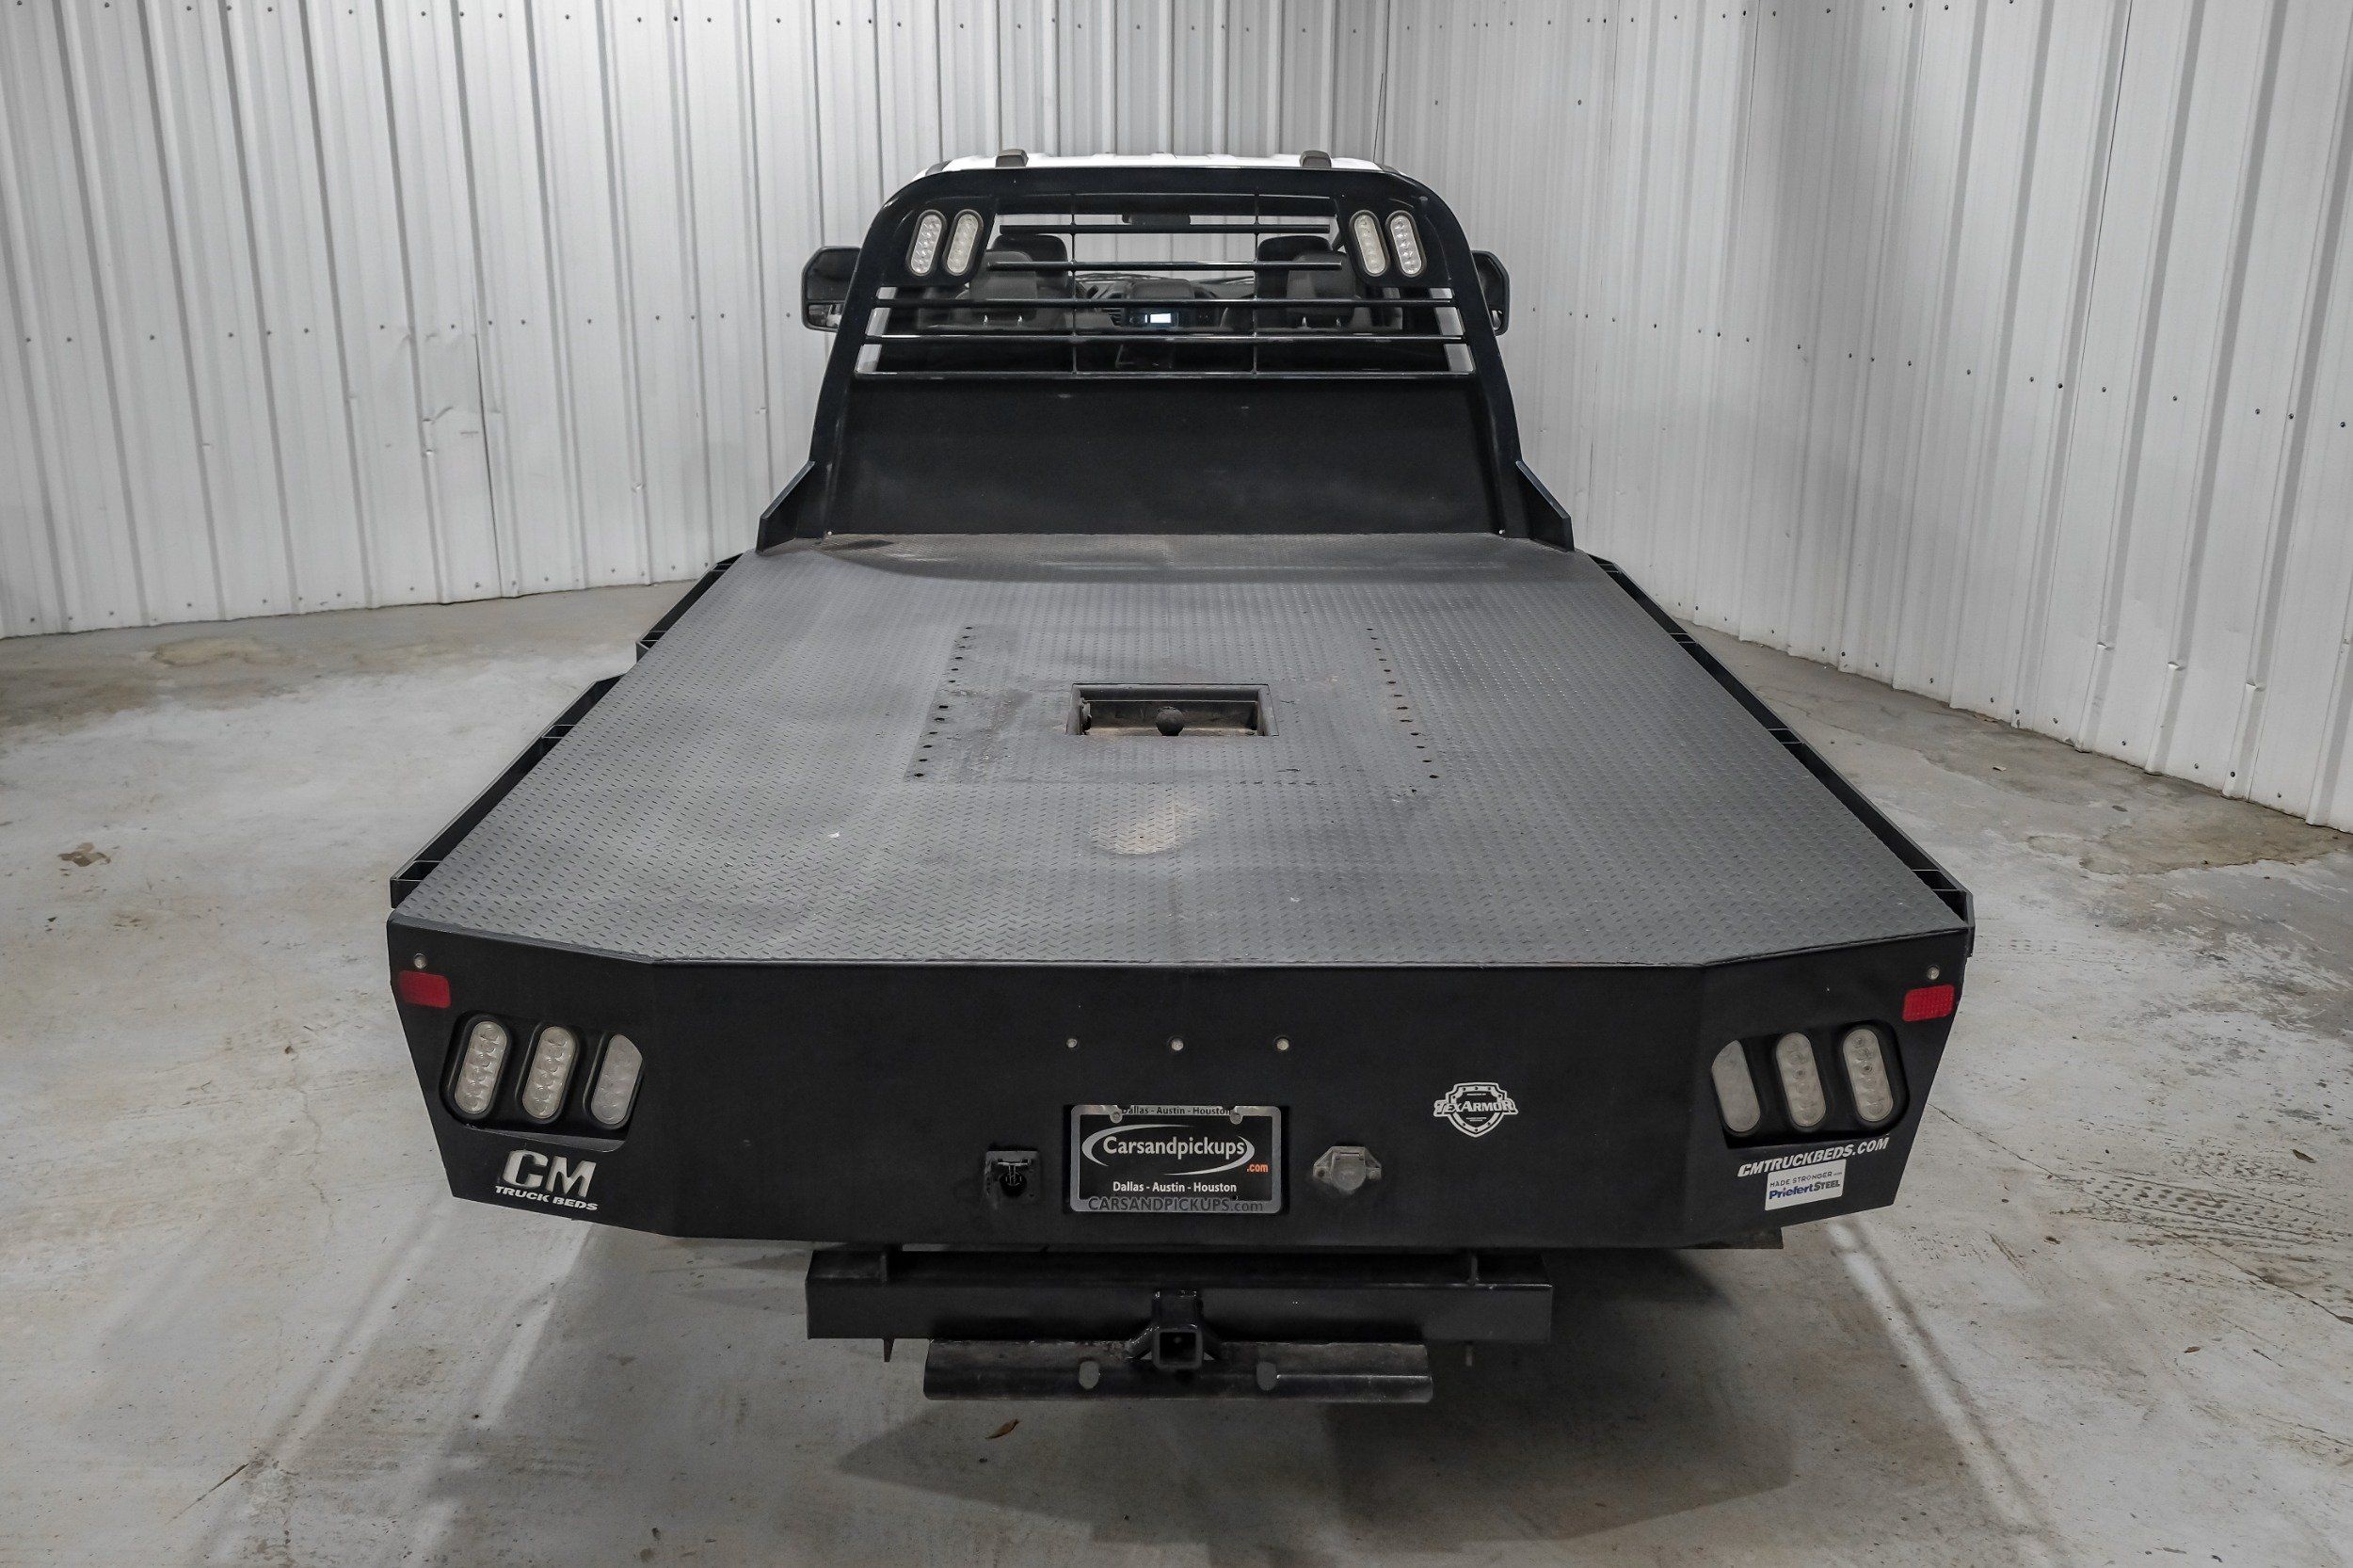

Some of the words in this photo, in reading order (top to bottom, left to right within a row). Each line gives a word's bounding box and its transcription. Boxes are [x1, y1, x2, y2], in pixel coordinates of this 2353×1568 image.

[1156, 1106, 1186, 1114] Austin
[1193, 1106, 1230, 1115] Houston
[1103, 1136, 1245, 1160] Carsandpickups
[1737, 1137, 1890, 1176] CMTRUCKBEDS.COM
[503, 1149, 597, 1197] CM
[1246, 1162, 1269, 1173] .com
[1112, 1181, 1144, 1192] Dallas
[1152, 1181, 1186, 1192] Austin
[1193, 1182, 1237, 1192] Houston
[1769, 1178, 1790, 1188] MADE
[1792, 1171, 1833, 1184] STRONGER
[495, 1186, 551, 1203] TRUCK
[552, 1196, 599, 1210] BEDS
[1088, 1196, 1263, 1212] CARSANDPICKUPS.com
